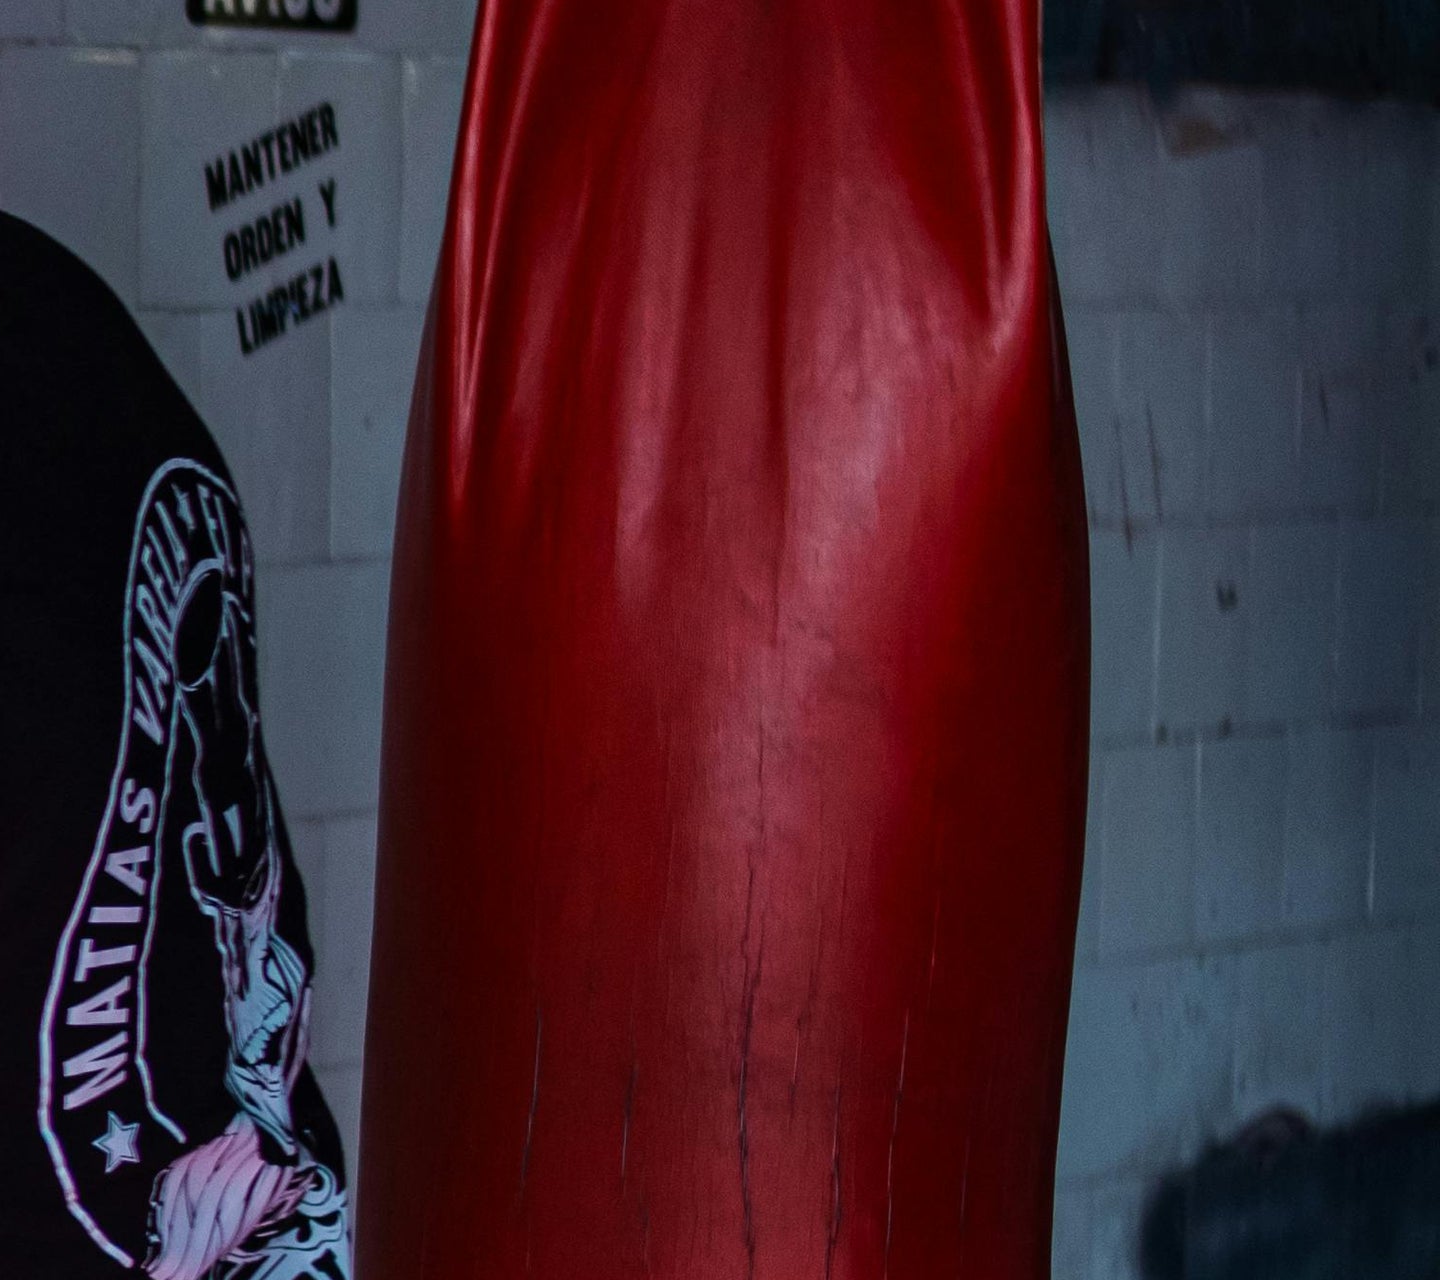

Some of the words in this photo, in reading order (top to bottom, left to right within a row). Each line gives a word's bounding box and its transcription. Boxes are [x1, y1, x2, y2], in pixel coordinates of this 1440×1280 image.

[204, 101, 340, 213] MANTENER
[223, 196, 307, 283] ORDEN
[318, 177, 338, 228] Y
[236, 257, 345, 357] LIMPIEZA
[62, 777, 157, 1111] MATIAS
